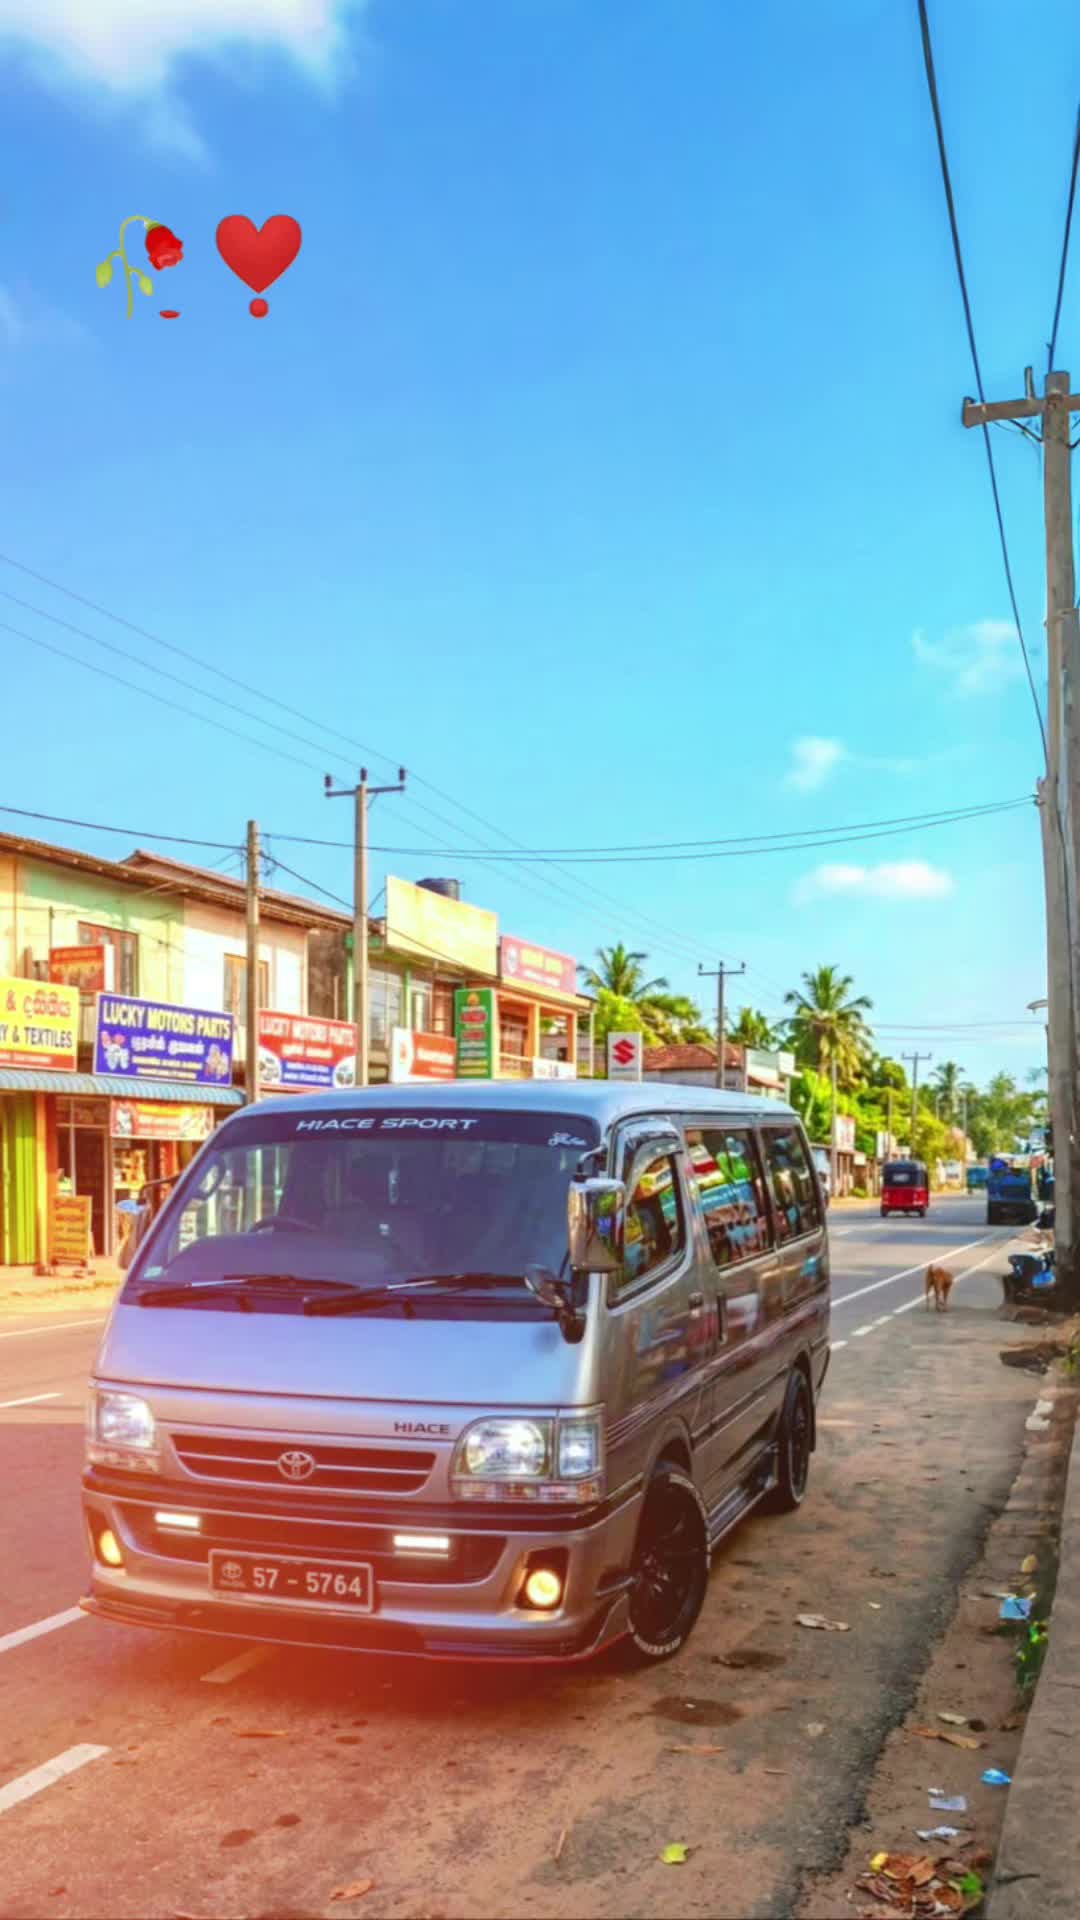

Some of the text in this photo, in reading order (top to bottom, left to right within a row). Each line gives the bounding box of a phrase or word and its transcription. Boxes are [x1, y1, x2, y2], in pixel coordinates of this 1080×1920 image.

[103, 1000, 145, 1028] LUCKY
[147, 1006, 195, 1036] MOTORS
[197, 1014, 231, 1040] PARTS
[24, 1026, 72, 1049] TEXTILES
[295, 1117, 478, 1131] HIACE SPORT
[394, 1421, 449, 1434] HIACE
[253, 1566, 279, 1590] 57
[306, 1571, 362, 1597] 5764
